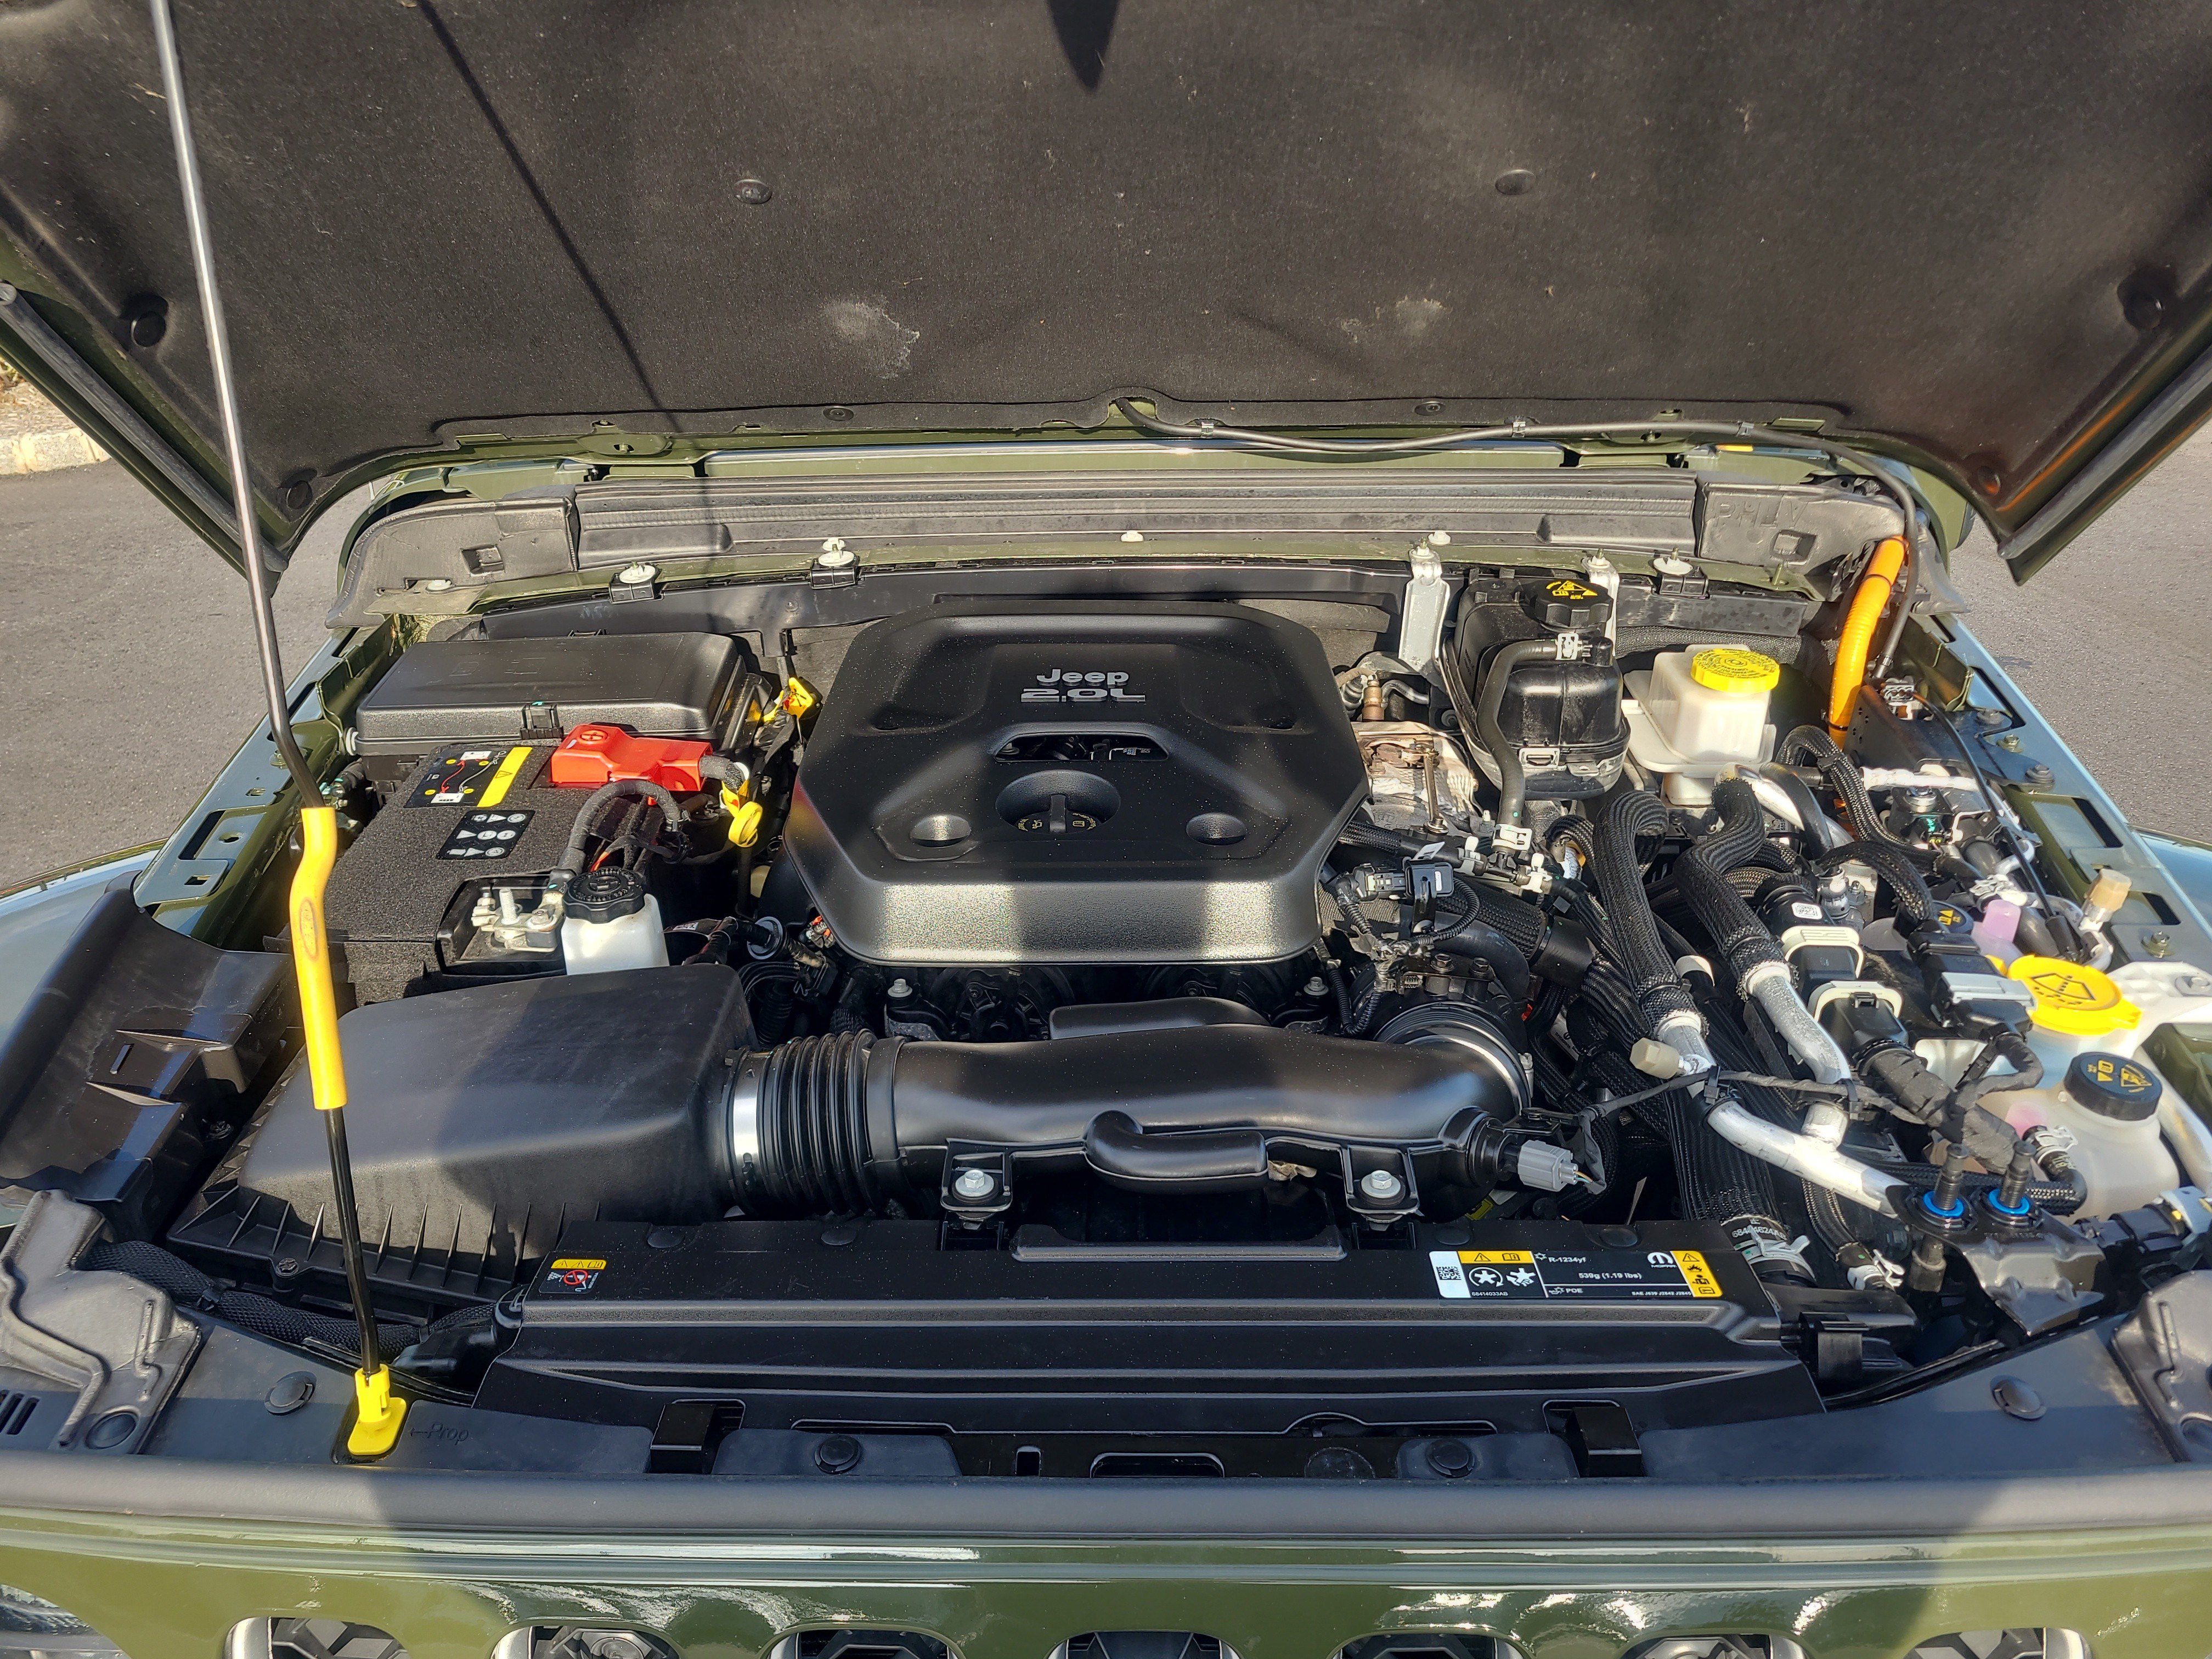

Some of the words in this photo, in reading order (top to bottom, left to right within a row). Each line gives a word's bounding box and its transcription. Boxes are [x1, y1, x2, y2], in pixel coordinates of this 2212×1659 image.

[1036, 669, 1129, 687] Jeep
[1020, 688, 1146, 702] 2.0L
[427, 1423, 469, 1446] Prop
